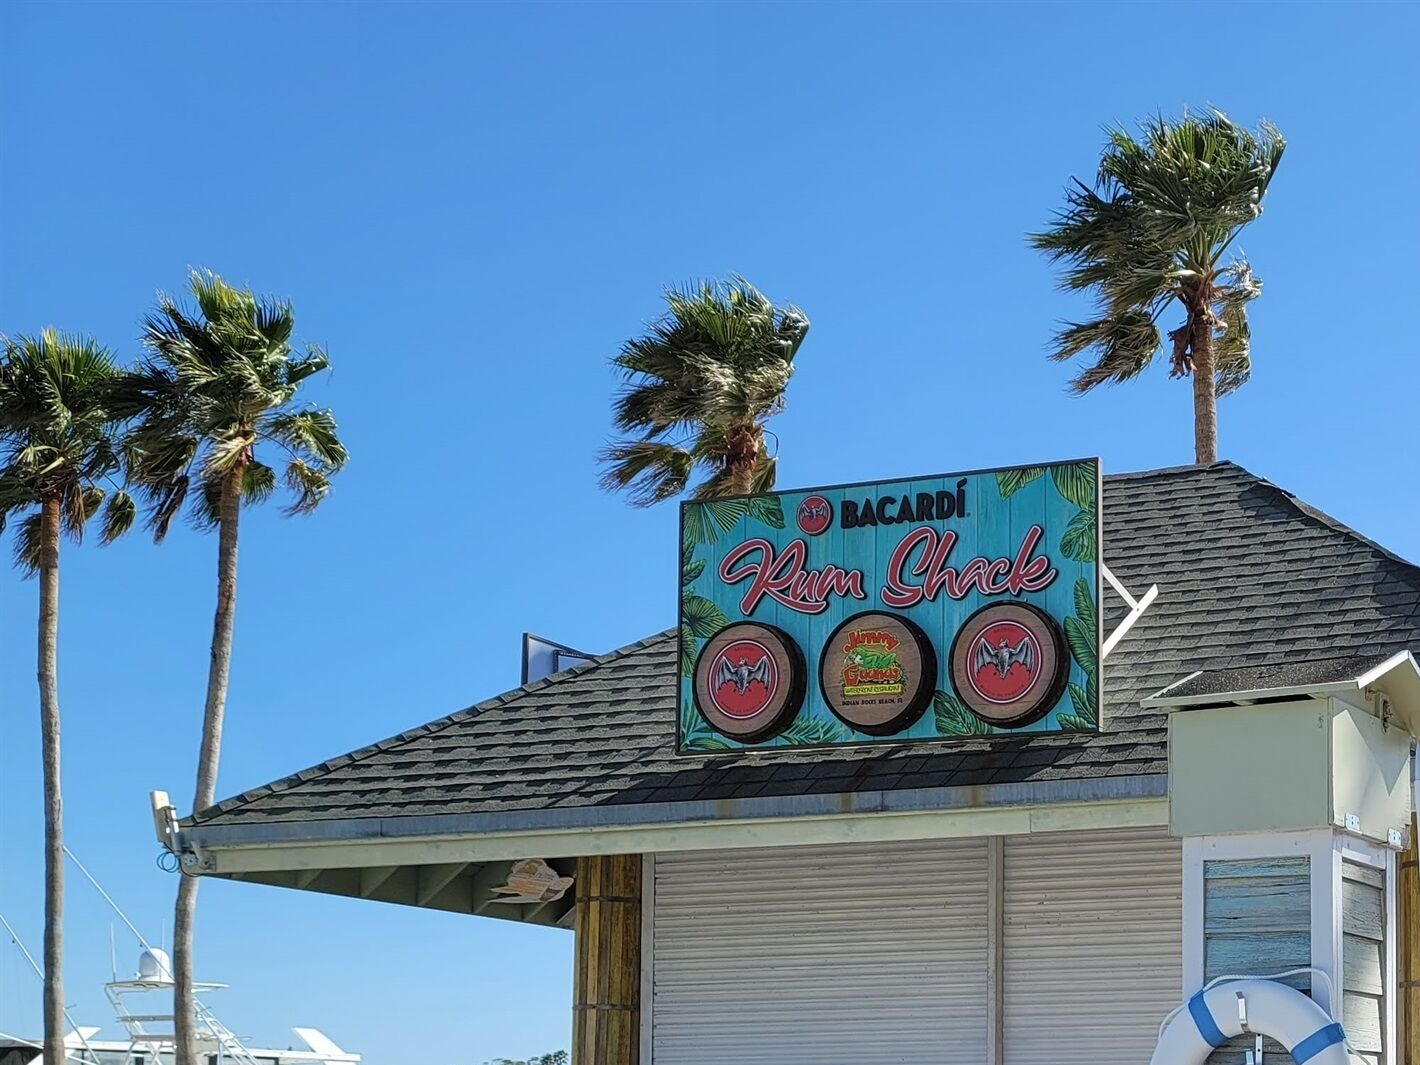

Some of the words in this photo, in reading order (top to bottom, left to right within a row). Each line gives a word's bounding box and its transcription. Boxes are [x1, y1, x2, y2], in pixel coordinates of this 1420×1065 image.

[840, 478, 968, 529] BACARDÍ
[719, 538, 866, 616] Rum
[880, 525, 1057, 608] Shack
